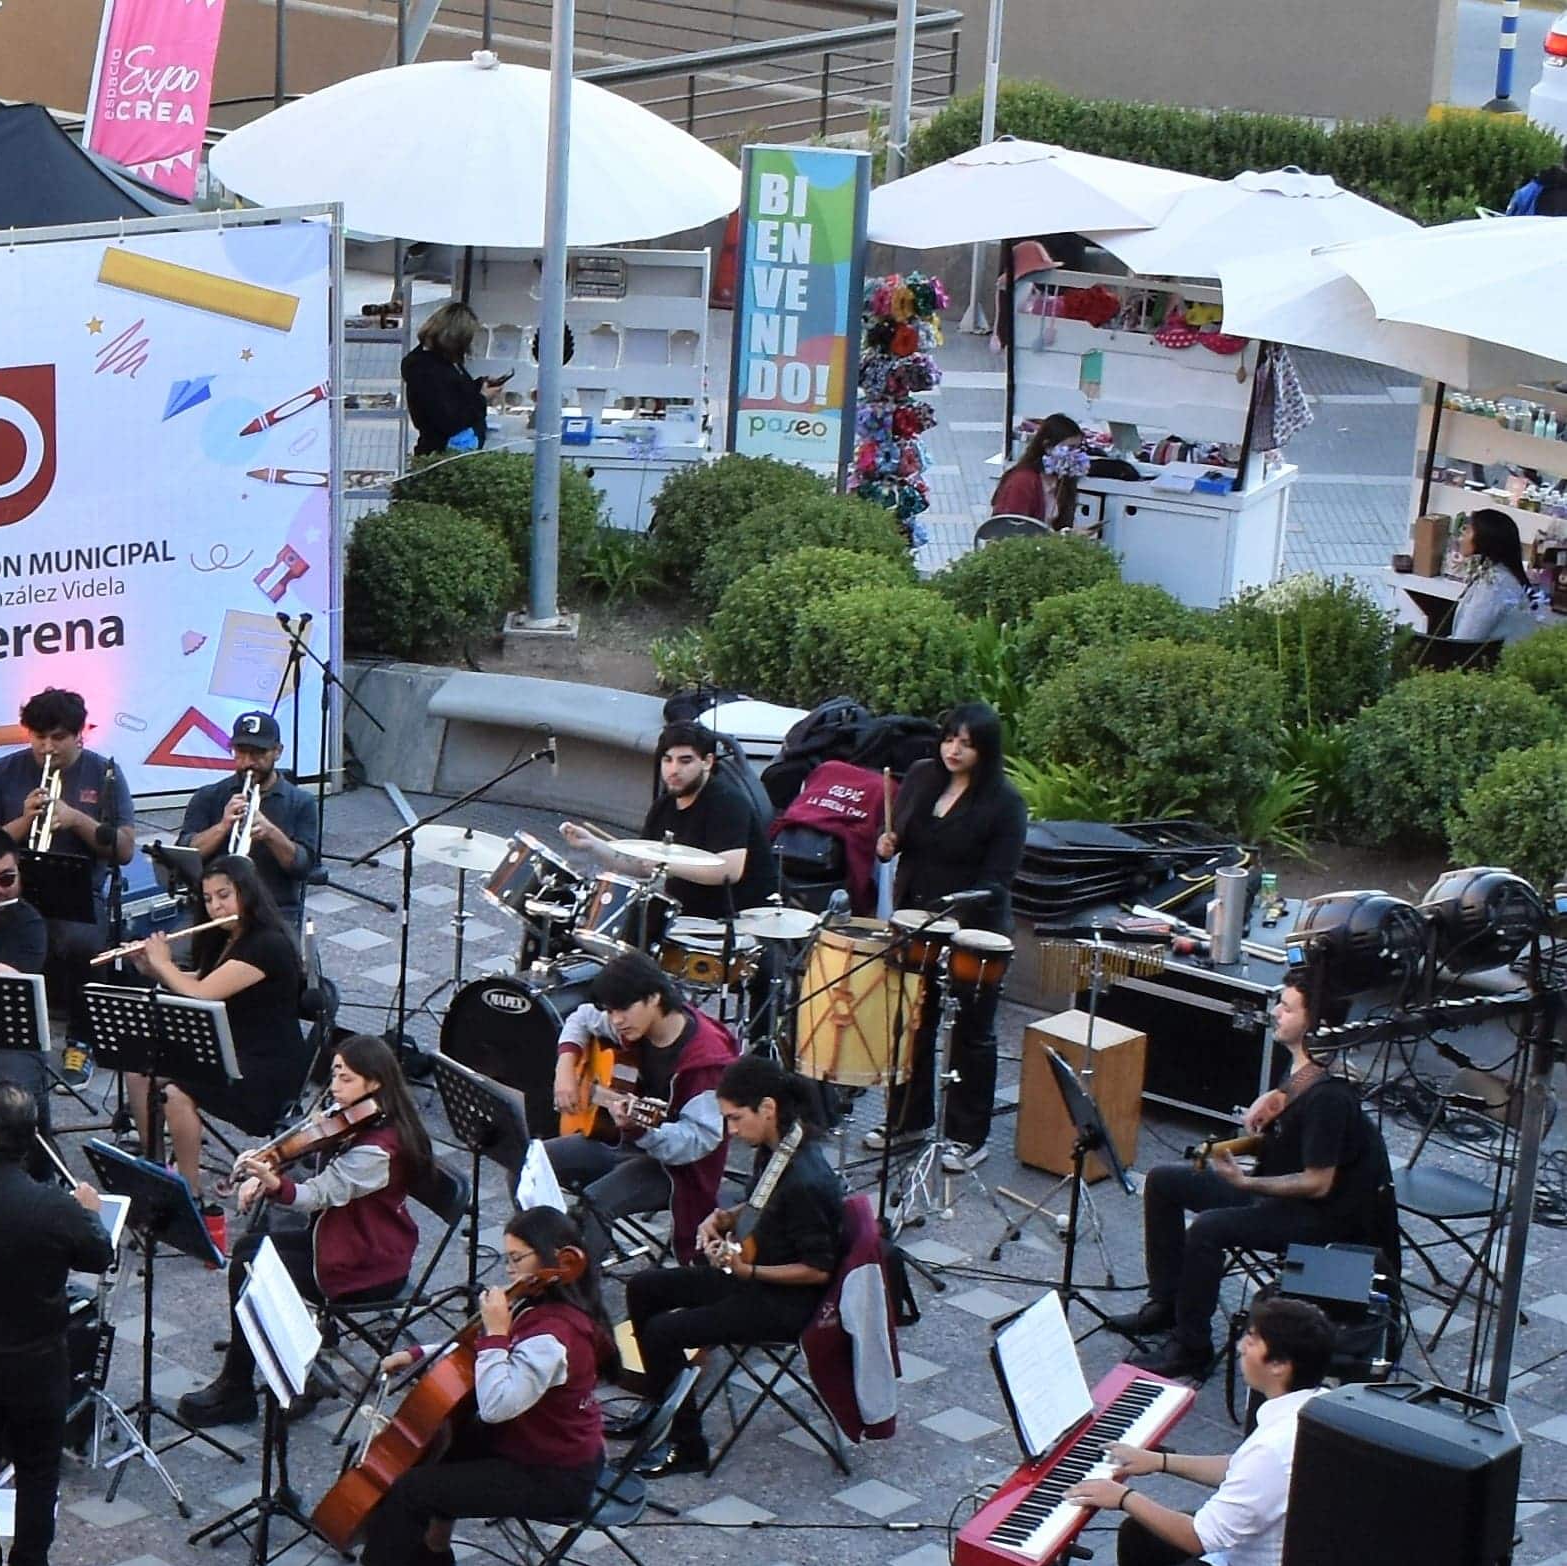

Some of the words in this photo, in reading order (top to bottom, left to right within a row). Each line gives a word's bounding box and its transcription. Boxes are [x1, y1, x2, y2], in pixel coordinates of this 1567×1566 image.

[105, 48, 122, 120] espacio
[119, 45, 200, 103] Expo
[116, 100, 195, 125] CREA
[759, 173, 808, 217] BI
[755, 220, 811, 264] EN
[752, 267, 808, 311] VE
[750, 313, 799, 357] NI
[747, 358, 829, 406] DO!
[748, 416, 828, 438] paseo
[28, 540, 175, 576] MUNICIPAL
[61, 577, 125, 600] Videla
